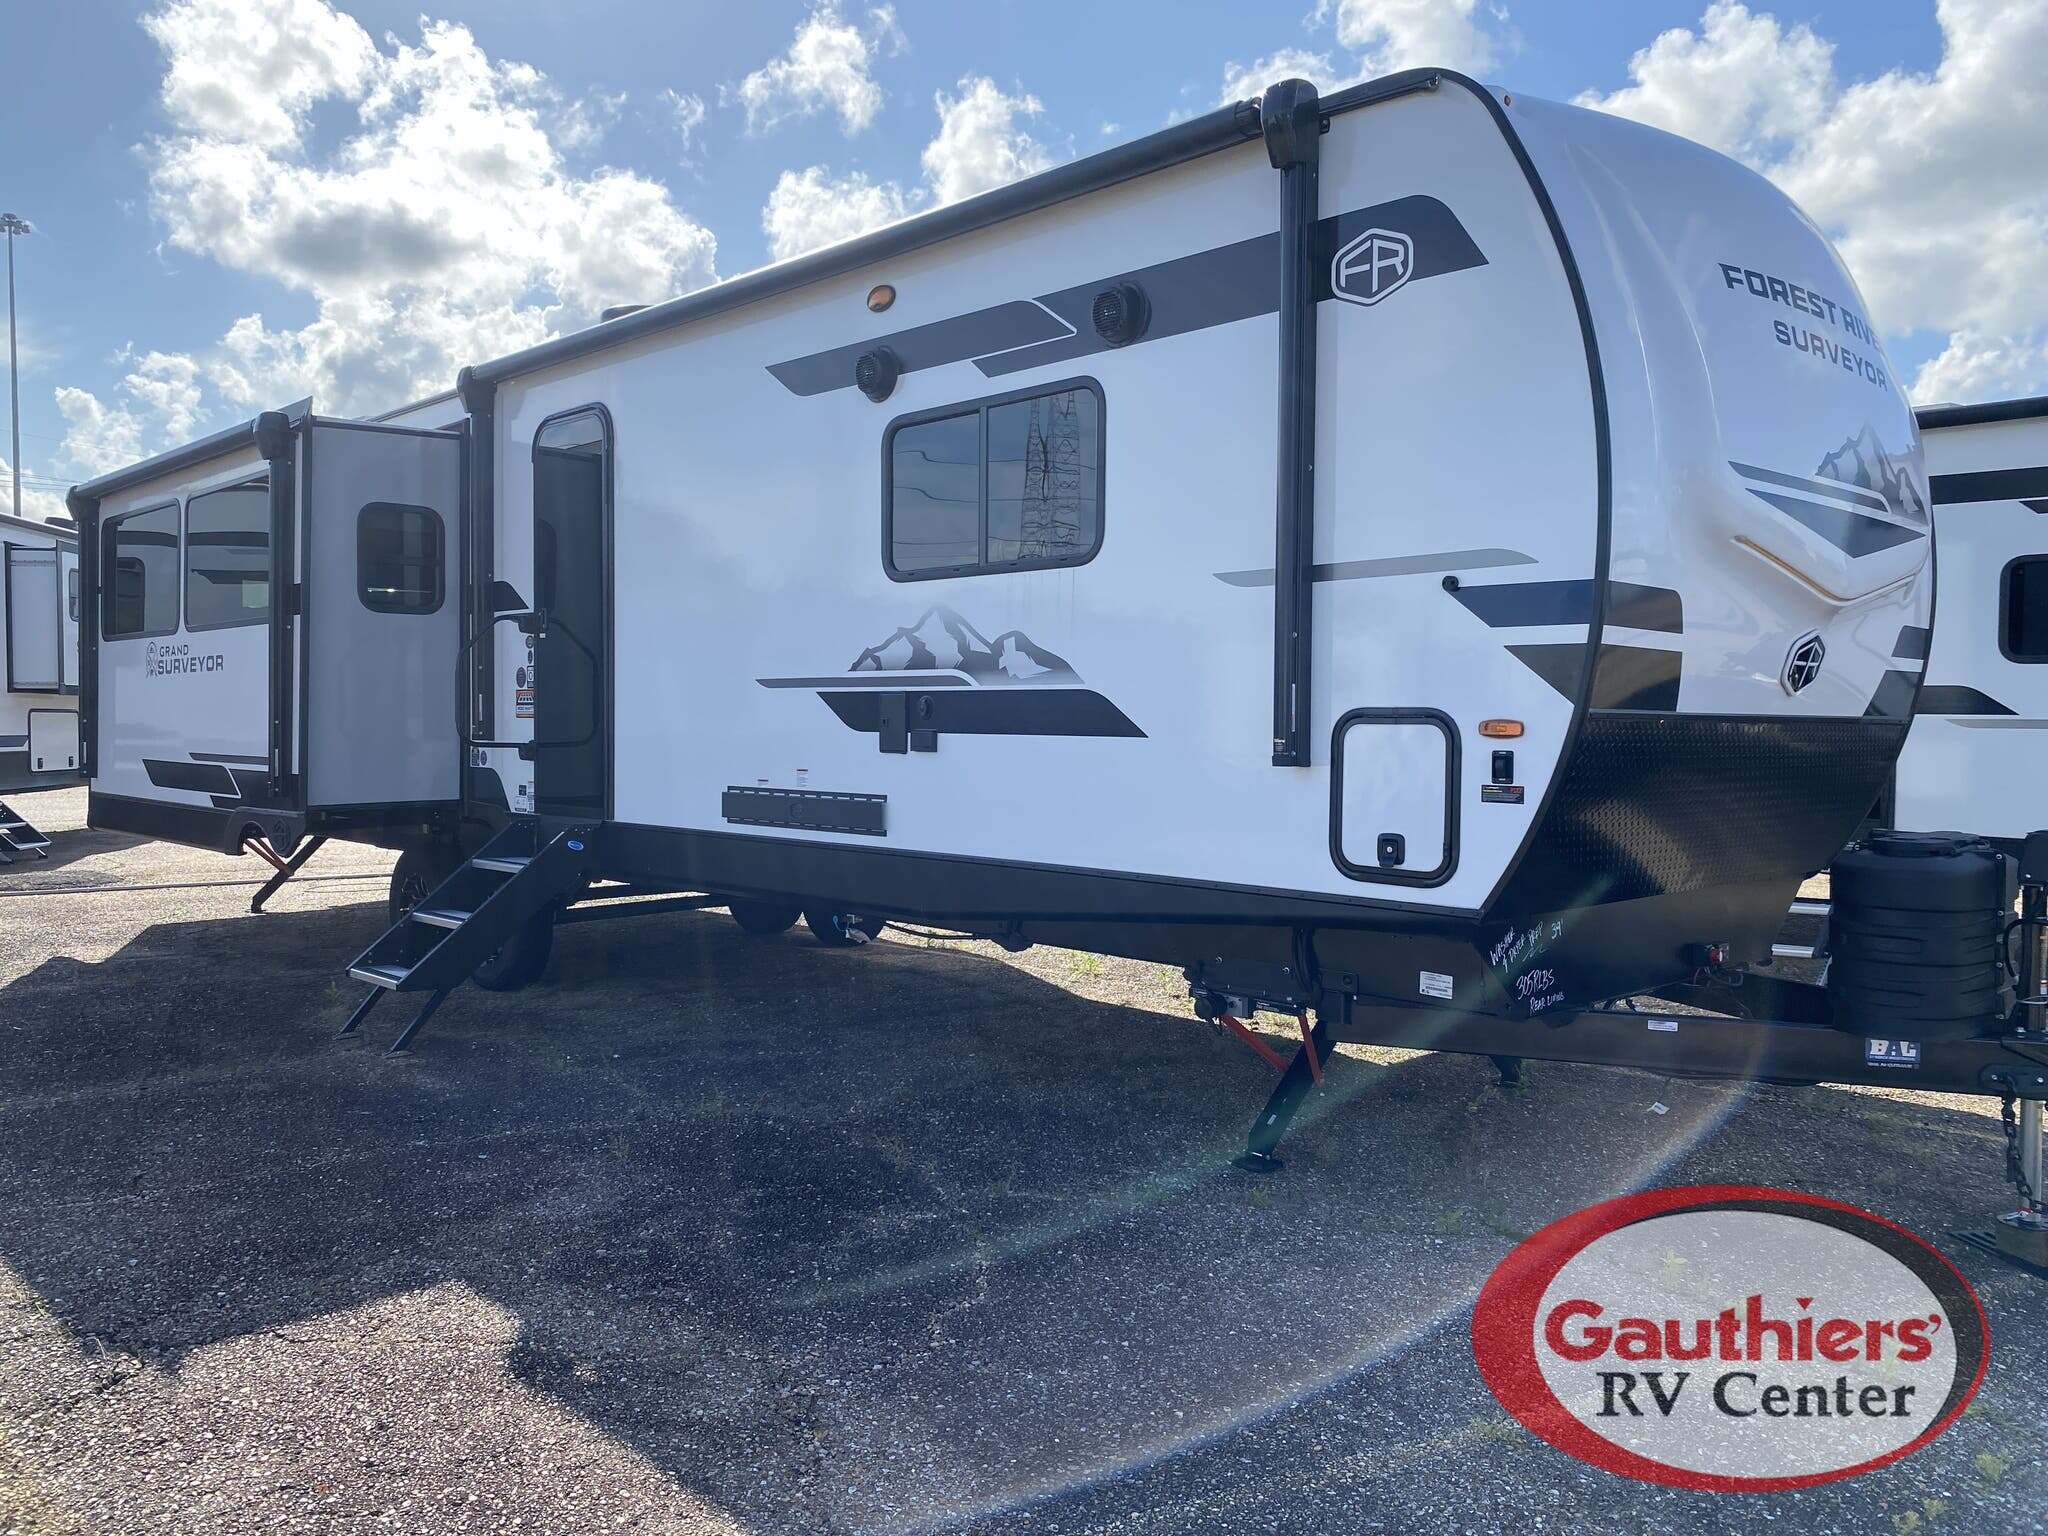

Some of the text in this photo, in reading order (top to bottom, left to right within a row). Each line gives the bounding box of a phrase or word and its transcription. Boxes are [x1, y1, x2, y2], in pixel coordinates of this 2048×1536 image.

[1718, 263, 1880, 350] FOREST RIVE
[1773, 320, 1888, 392] SURVEYOR
[157, 654, 224, 675] SURVEYOR
[159, 644, 189, 657] GRAND
